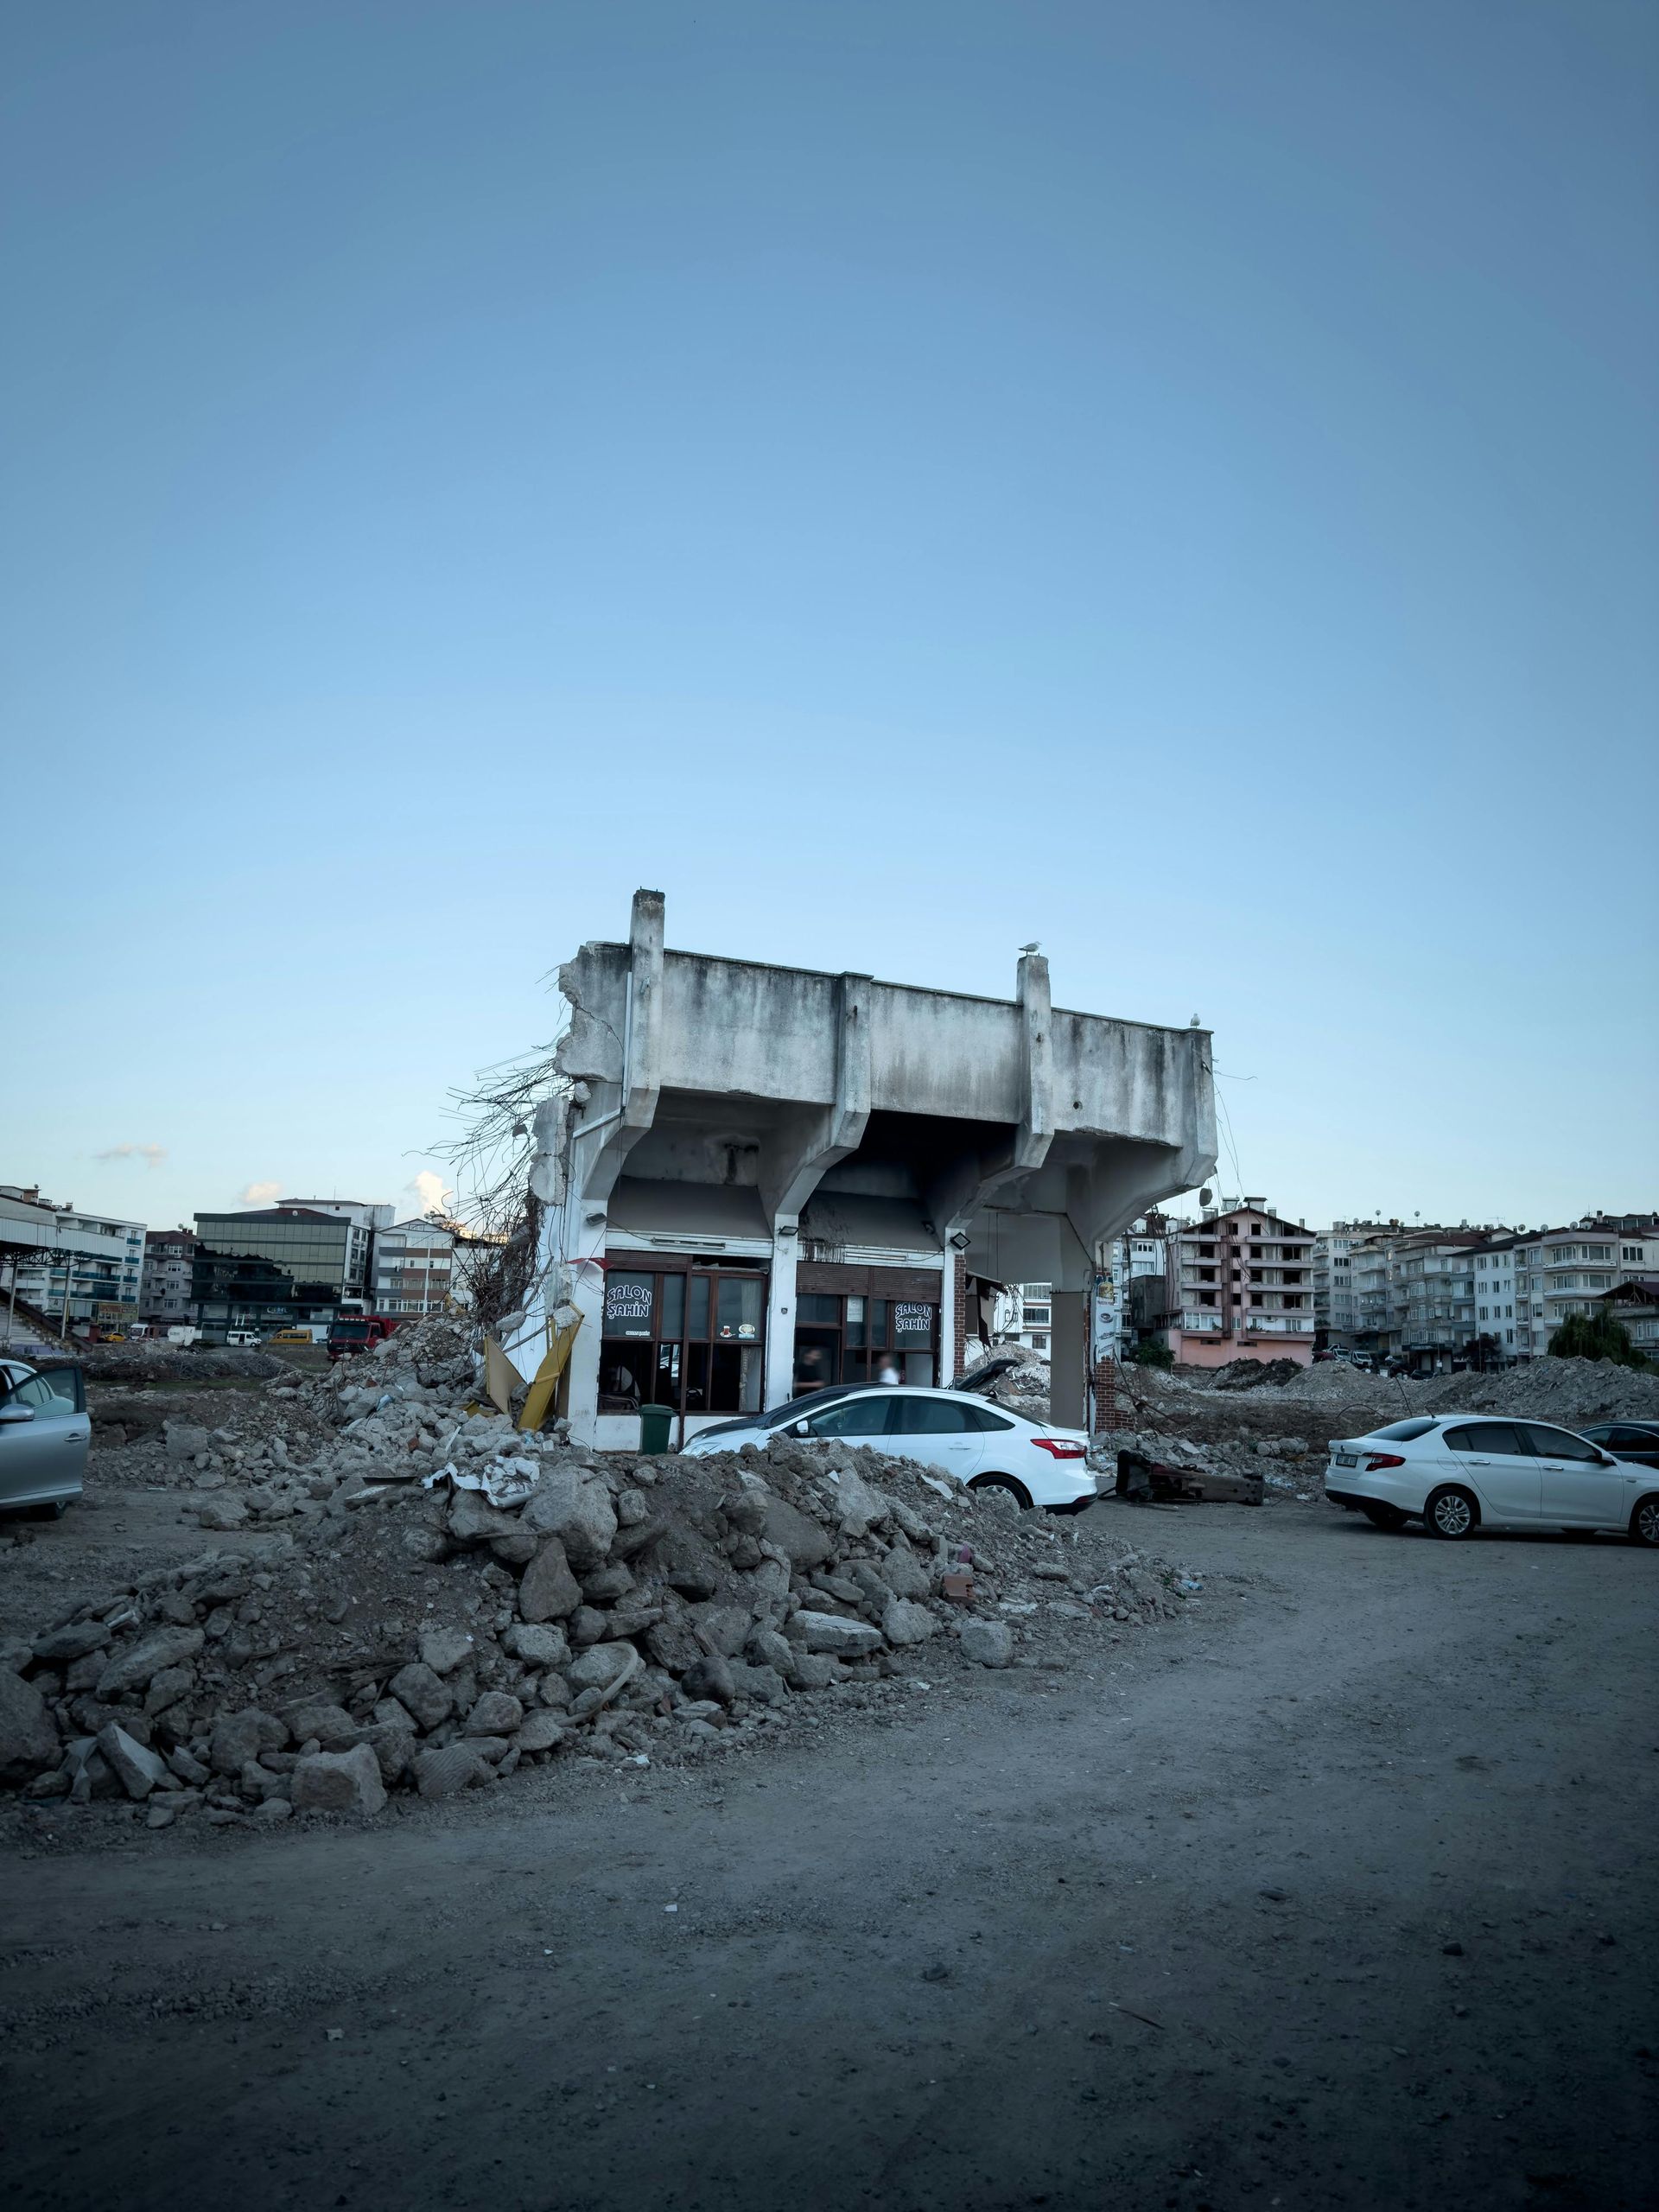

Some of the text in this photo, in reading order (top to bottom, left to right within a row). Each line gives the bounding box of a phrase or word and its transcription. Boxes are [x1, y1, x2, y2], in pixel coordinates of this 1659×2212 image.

[607, 1285, 652, 1306] SALON
[607, 1301, 649, 1319] ŞAHİN
[895, 1302, 932, 1319] SALON
[895, 1316, 930, 1332] ŞAHİN
